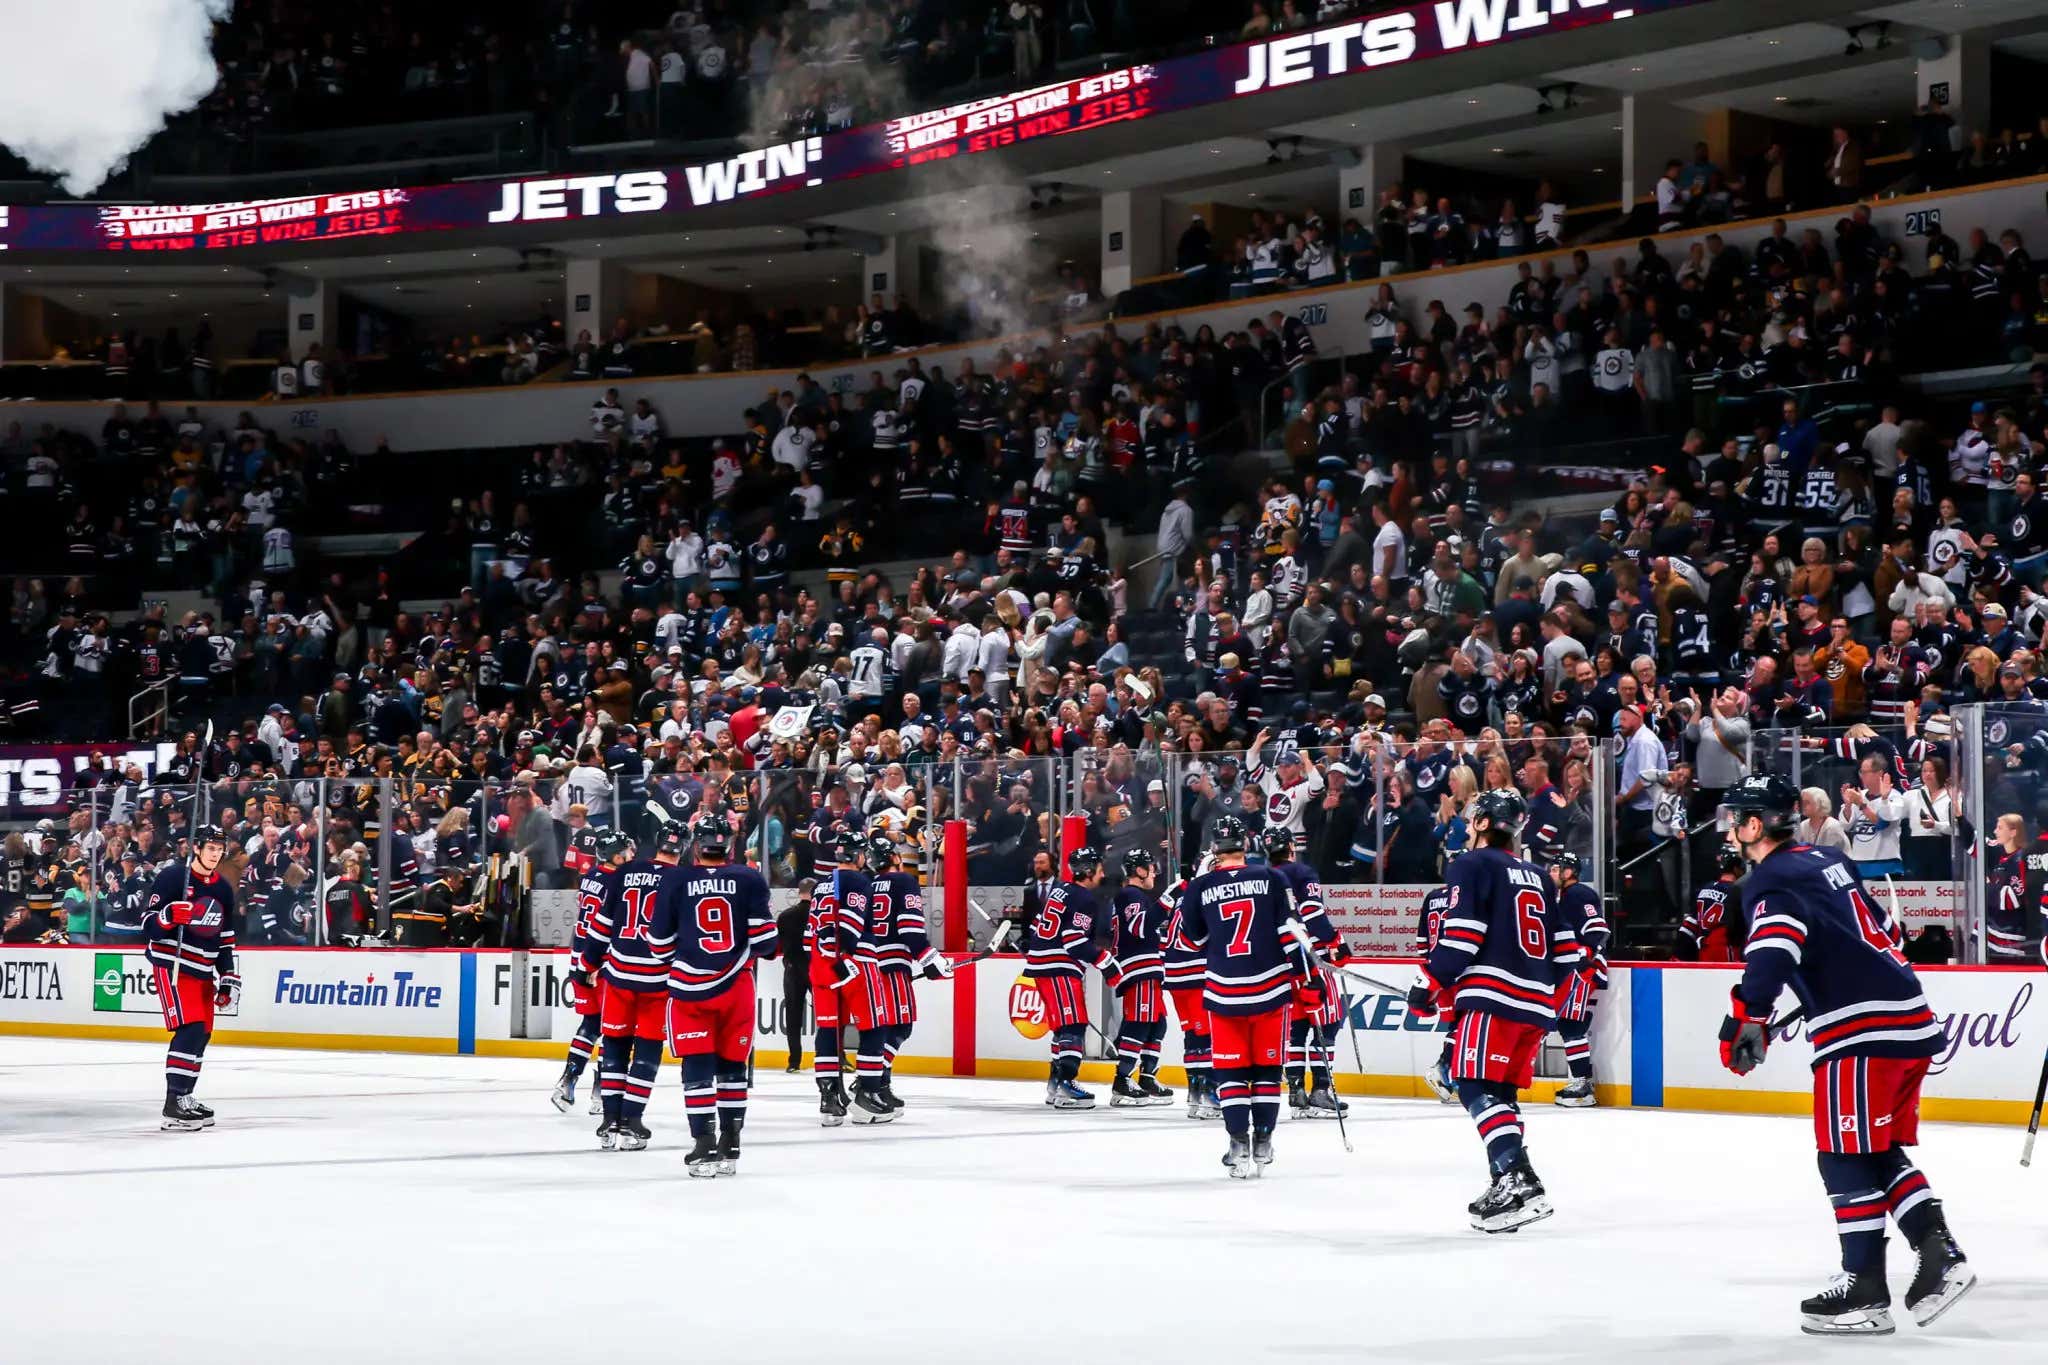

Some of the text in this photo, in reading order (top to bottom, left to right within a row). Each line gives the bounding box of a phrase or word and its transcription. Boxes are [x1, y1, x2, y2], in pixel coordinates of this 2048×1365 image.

[1235, 0, 1634, 94] JETS WI
[964, 103, 1014, 133] JETS
[1076, 69, 1130, 101] JETS
[1079, 93, 1131, 123] JETS
[488, 136, 822, 223] JETS WIN!
[203, 209, 257, 231] JETS
[324, 191, 380, 214] JETS
[205, 229, 257, 249] JETS
[327, 211, 380, 233] JETS
[1299, 304, 1327, 325] 217
[1761, 480, 1788, 506] 31
[1804, 481, 1835, 510] 55
[1001, 516, 1027, 539] 44
[1695, 623, 1710, 653] 4
[854, 656, 877, 682] 17
[1744, 777, 1770, 788] Bell
[688, 879, 737, 896] IAFALLO
[871, 880, 891, 892] TON
[1201, 879, 1260, 906] NAMESTNIKOV
[1328, 888, 1425, 899] Scotiabank Scotiabank
[1870, 886, 1927, 897] Scotabank
[576, 892, 602, 939] 3
[695, 896, 735, 954] 9
[1037, 897, 1067, 940] 5
[1354, 906, 1398, 917] Scotiabank
[1515, 889, 1547, 960] 6
[1218, 897, 1256, 958] 7
[1353, 941, 1398, 952] Scotiabank
[95, 968, 157, 996] ente
[275, 970, 442, 1007] Fountain Tire
[1011, 985, 1046, 1025] Lay
[676, 1031, 708, 1040] CCM
[1931, 982, 2033, 1066] yal
